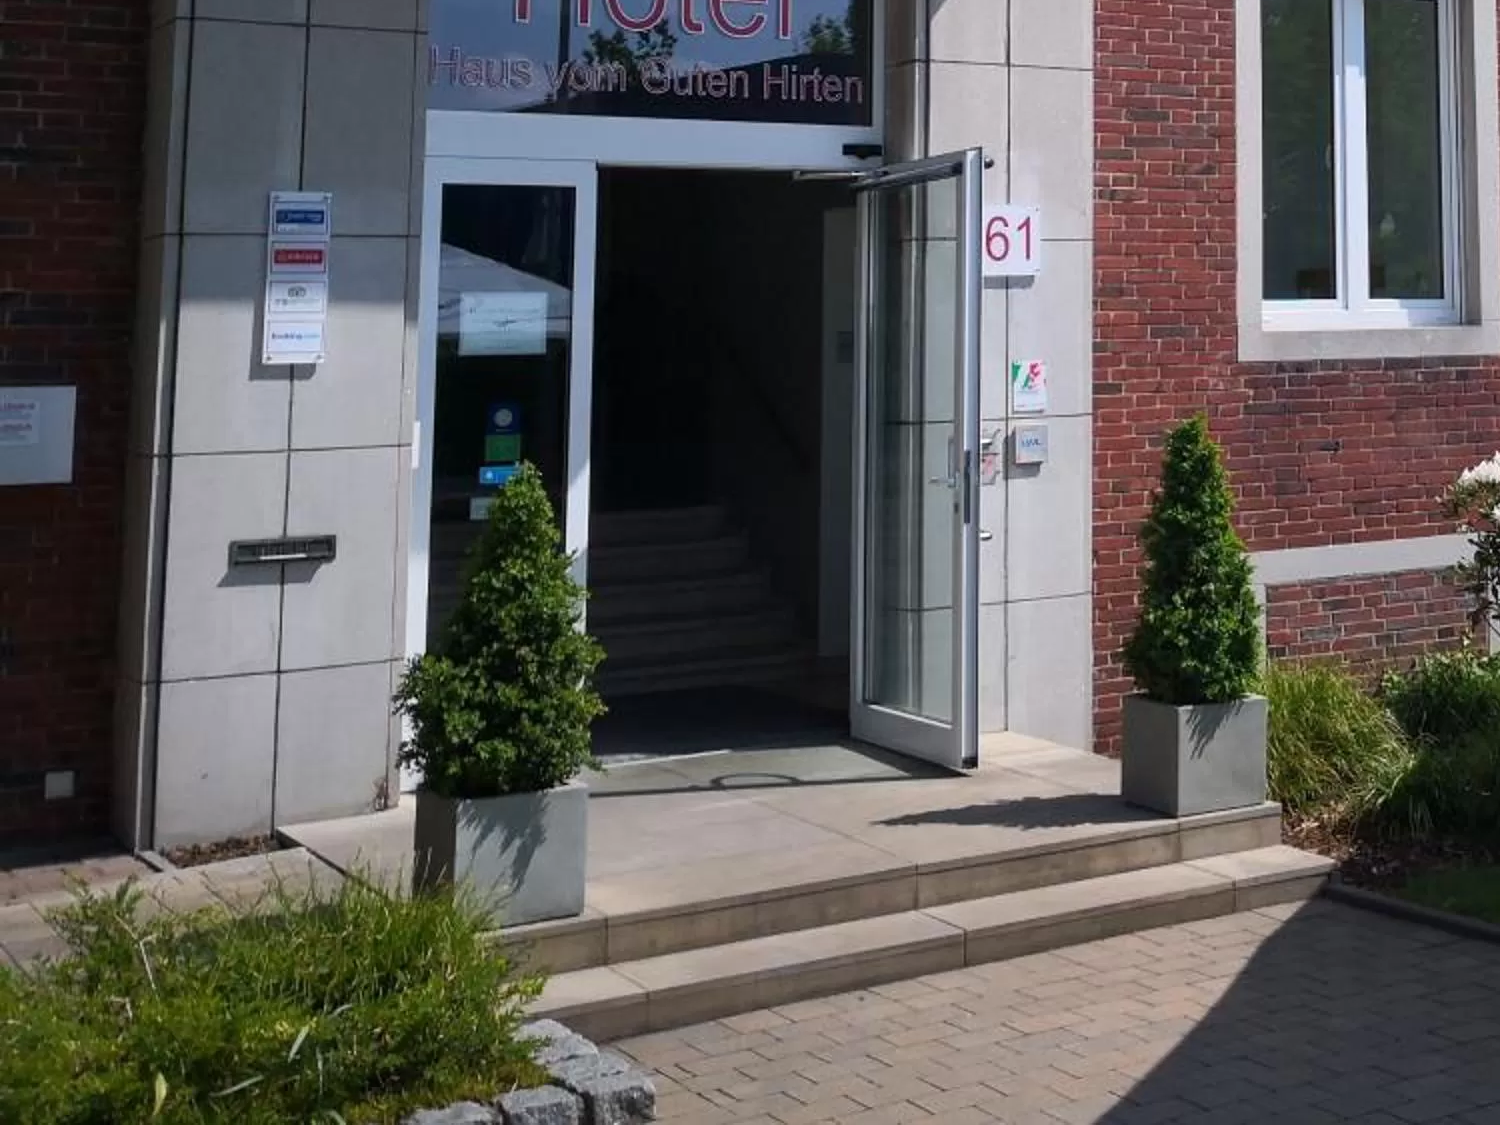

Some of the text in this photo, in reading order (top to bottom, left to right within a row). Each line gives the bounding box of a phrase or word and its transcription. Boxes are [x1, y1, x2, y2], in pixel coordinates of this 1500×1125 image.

[428, 43, 864, 104] Haus vom Guten Hirten
[985, 216, 1031, 262] 61
